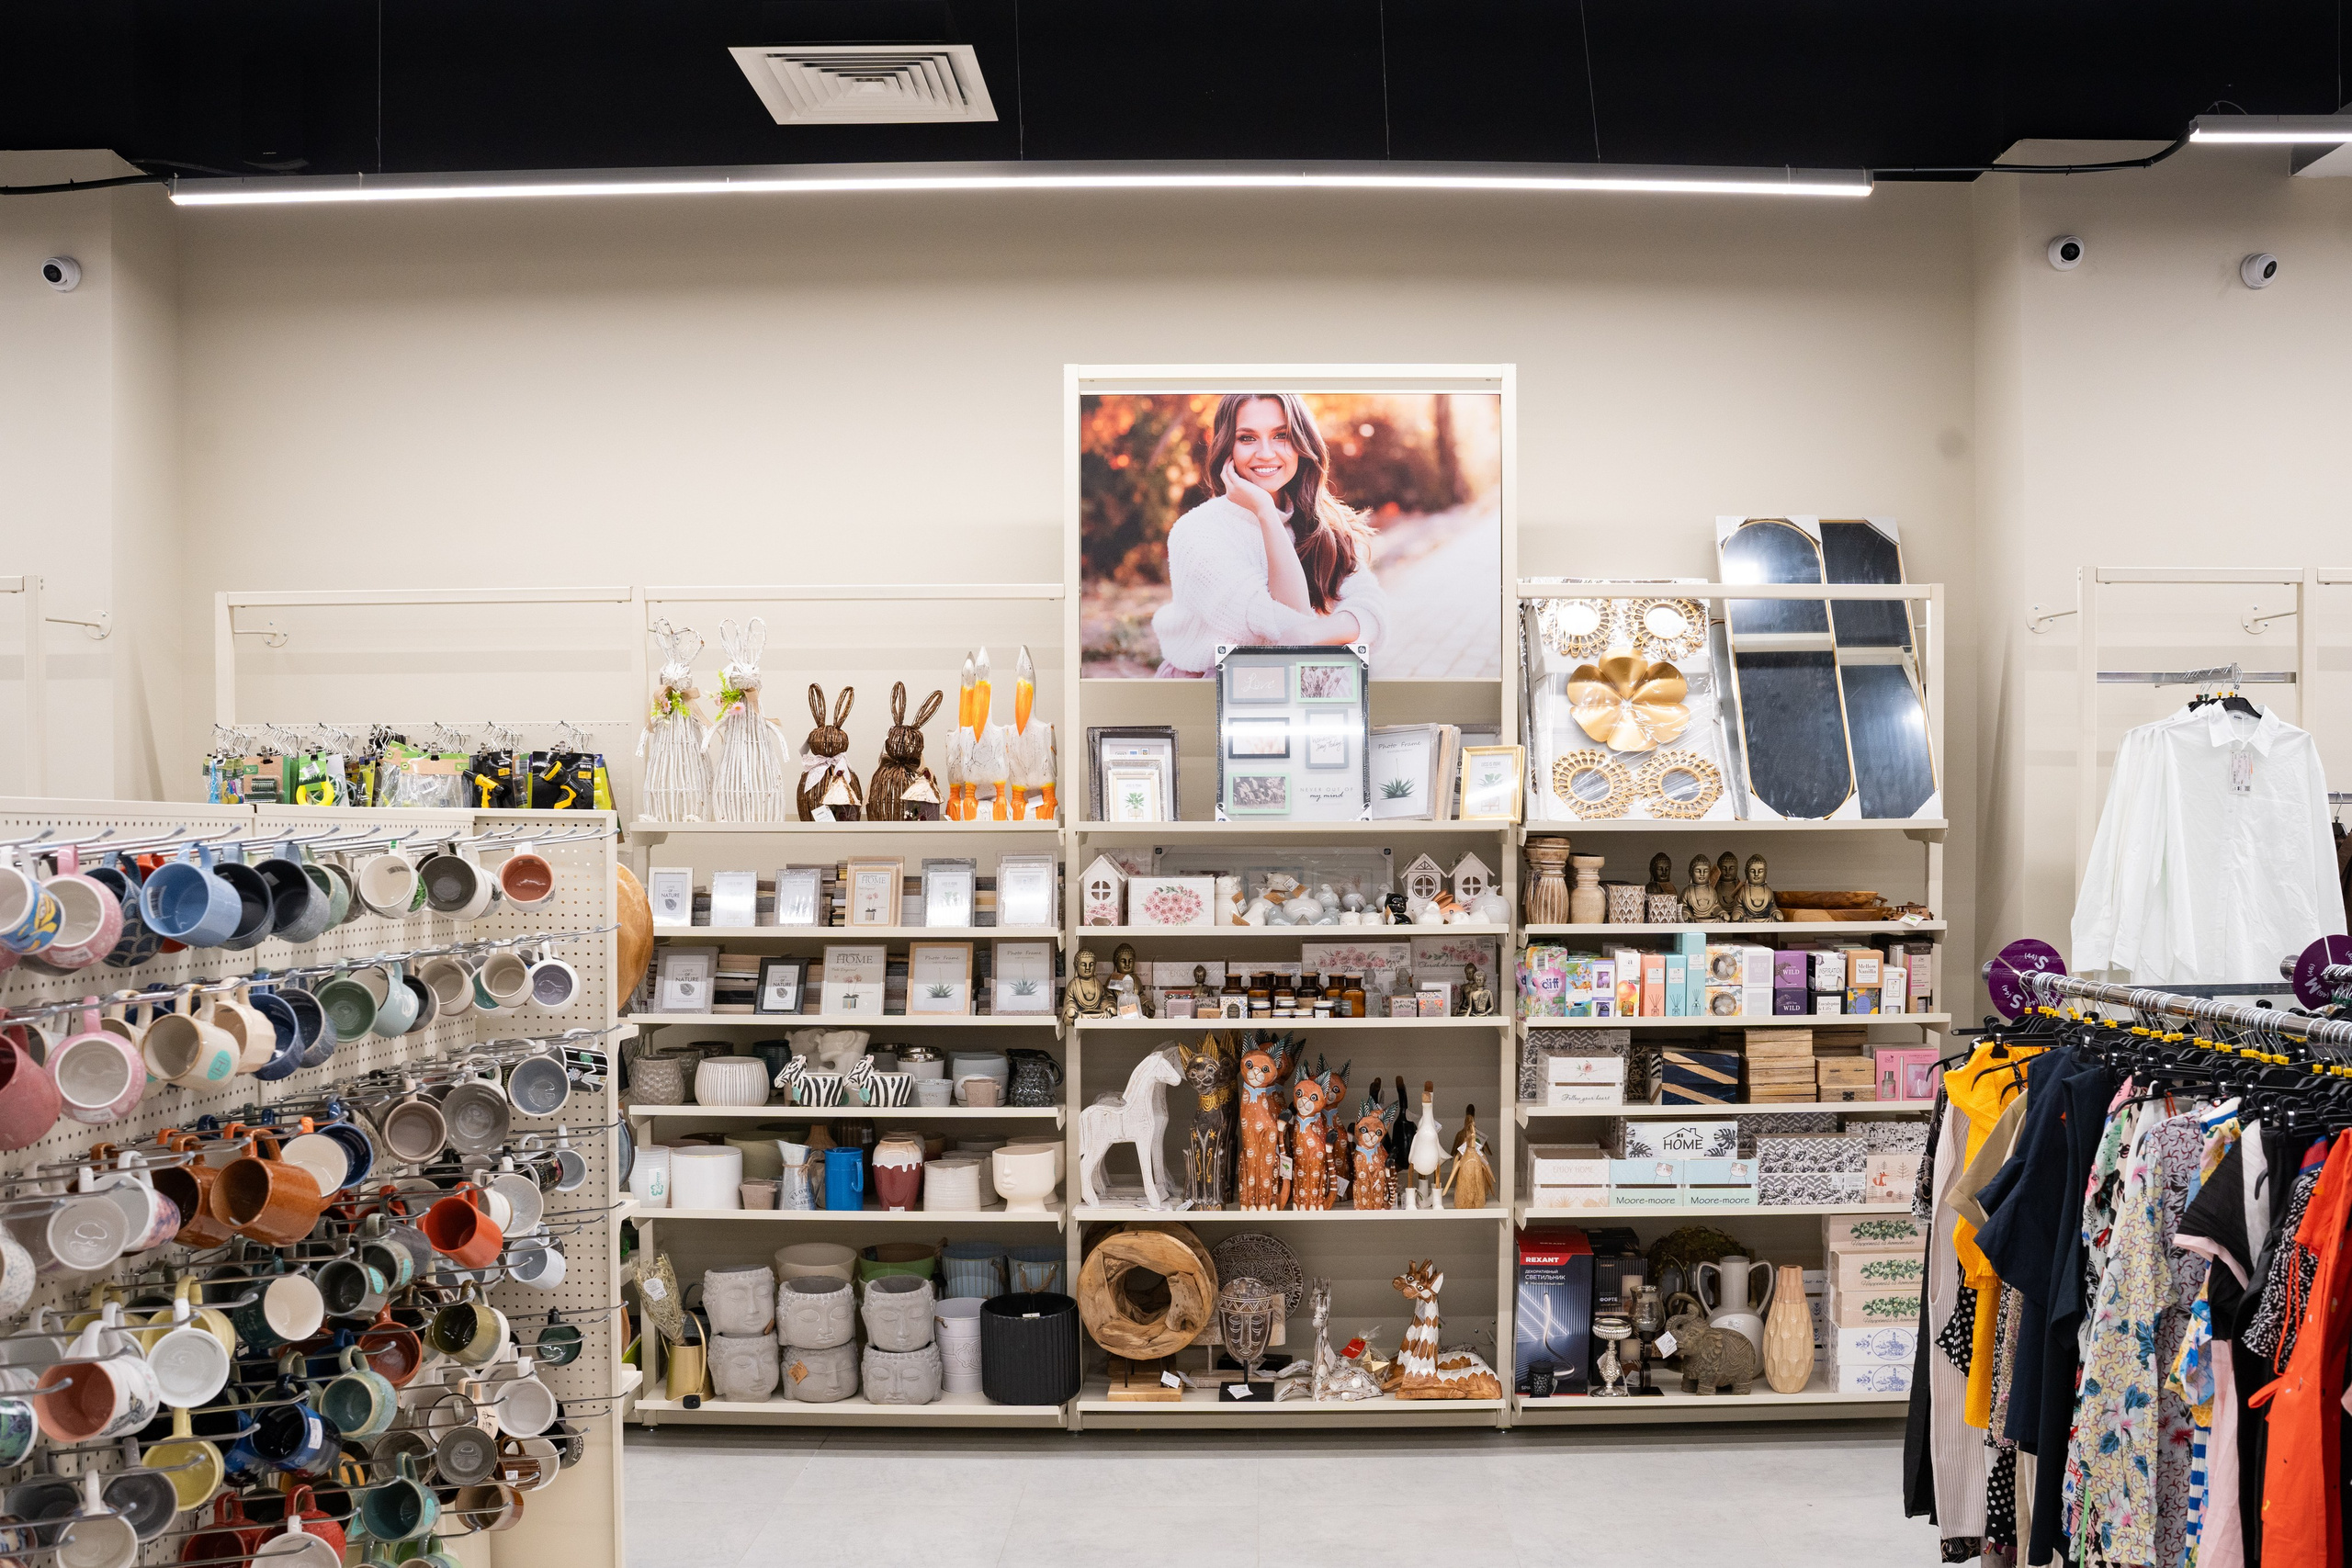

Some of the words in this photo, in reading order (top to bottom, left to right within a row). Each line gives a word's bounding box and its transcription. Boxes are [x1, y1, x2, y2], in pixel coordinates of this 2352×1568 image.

[1241, 672, 1275, 692] Love
[1310, 794, 1321, 802] my
[862, 876, 887, 885] HOME
[836, 955, 873, 964] HOME
[2024, 953, 2038, 961] (44)
[2034, 955, 2049, 970] S
[2307, 964, 2315, 977] (46)
[1542, 978, 1560, 989] diff
[2304, 976, 2322, 995] M
[2316, 989, 2330, 998] (46)
[2009, 994, 2023, 1009] S
[1562, 1093, 1580, 1101] Follow
[1663, 1139, 1703, 1150] HOME
[1616, 1196, 1676, 1204] Moore-moore
[1690, 1196, 1750, 1204] Moore-moore
